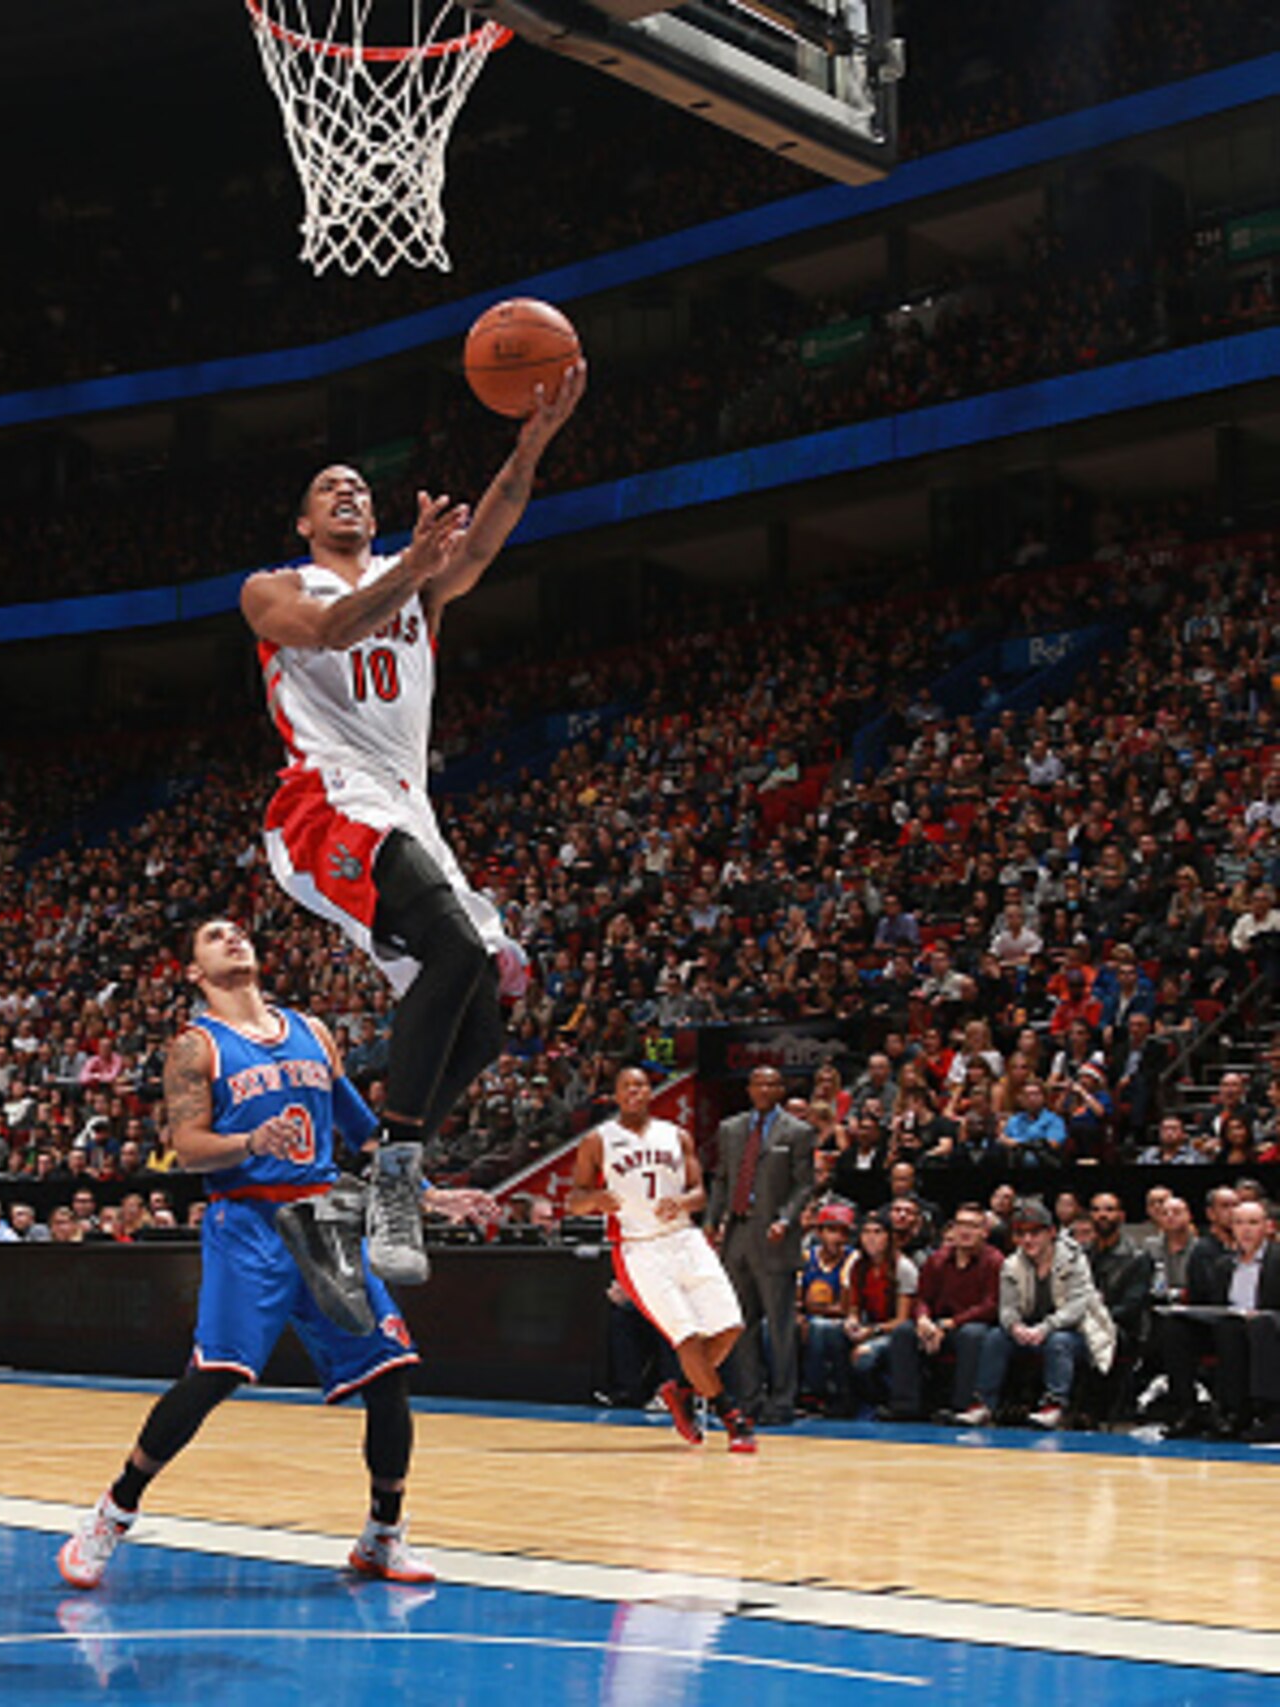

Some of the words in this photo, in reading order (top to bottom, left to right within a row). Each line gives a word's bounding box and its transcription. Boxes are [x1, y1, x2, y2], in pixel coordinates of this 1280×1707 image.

[350, 648, 399, 702] 10
[226, 1064, 282, 1105] NEW
[280, 1059, 333, 1092] YORK
[282, 1103, 316, 1165] 0
[641, 1171, 656, 1200] 7
